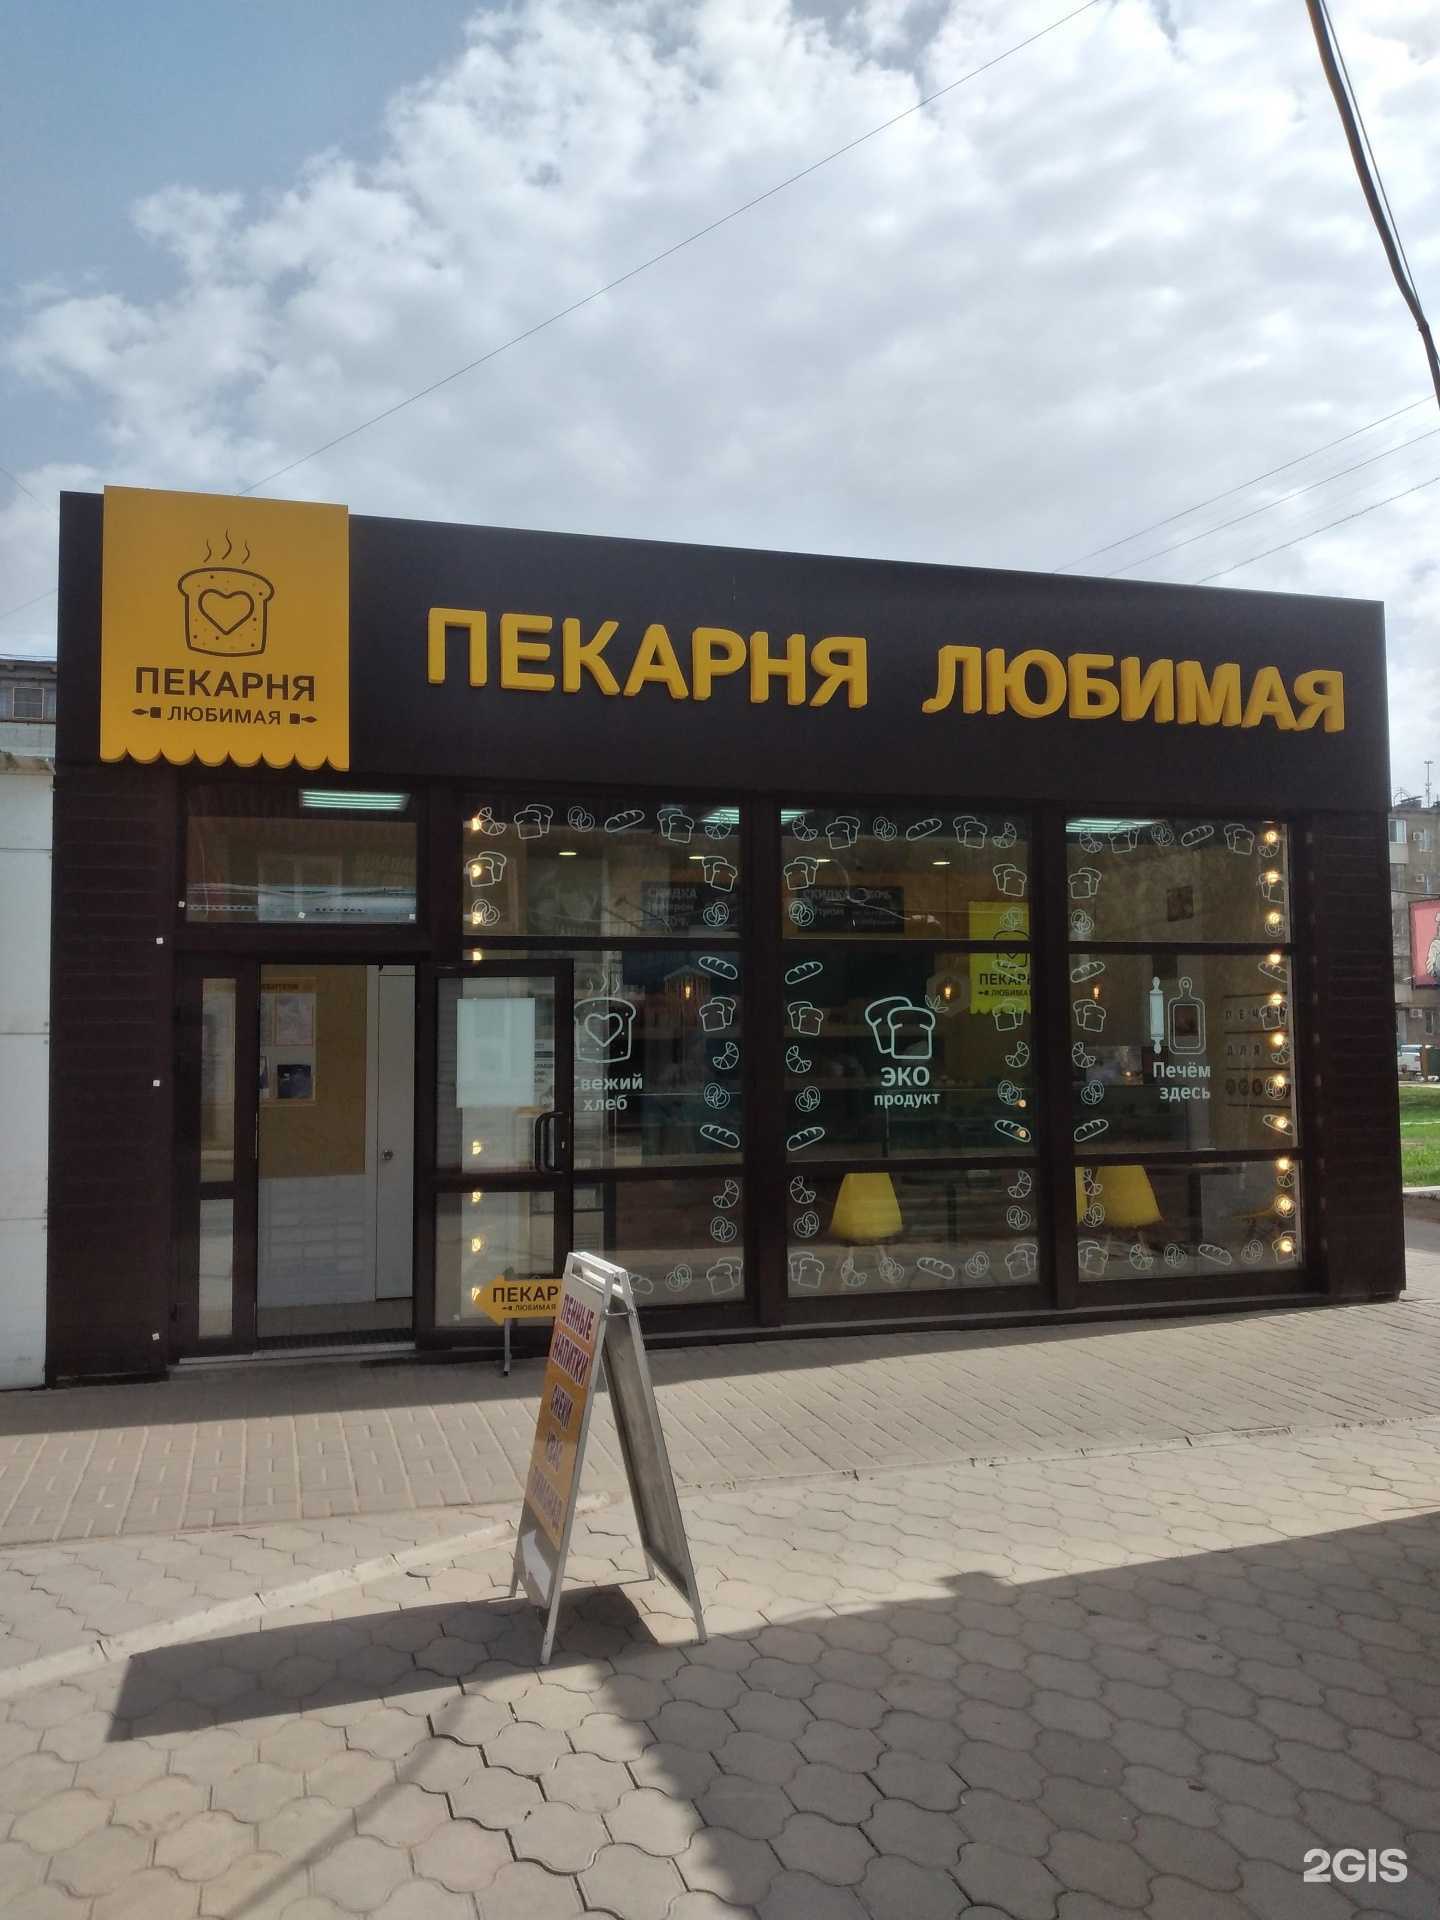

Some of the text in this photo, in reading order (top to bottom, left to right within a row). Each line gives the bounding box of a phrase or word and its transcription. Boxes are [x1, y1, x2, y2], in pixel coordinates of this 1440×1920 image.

[427, 607, 1346, 733] ПЕКАРНЯ ЛЮБИМАЯ
[136, 666, 315, 702] ПЕКАРНЯ
[167, 706, 281, 725] ЛЮБИМАЯ
[880, 1066, 930, 1087] ЭКО
[1153, 1061, 1211, 1078] Печём
[574, 1073, 643, 1090] вежий
[583, 1094, 628, 1111] хлеб
[874, 1093, 941, 1109] продукт
[1159, 1087, 1211, 1102] здесь
[493, 1286, 561, 1302] ПЕКАР
[515, 1304, 557, 1312] ЛЮБИМАЯ
[560, 1293, 595, 1341] ПЕННЫЕ
[551, 1332, 590, 1386] НАПИТКИ
